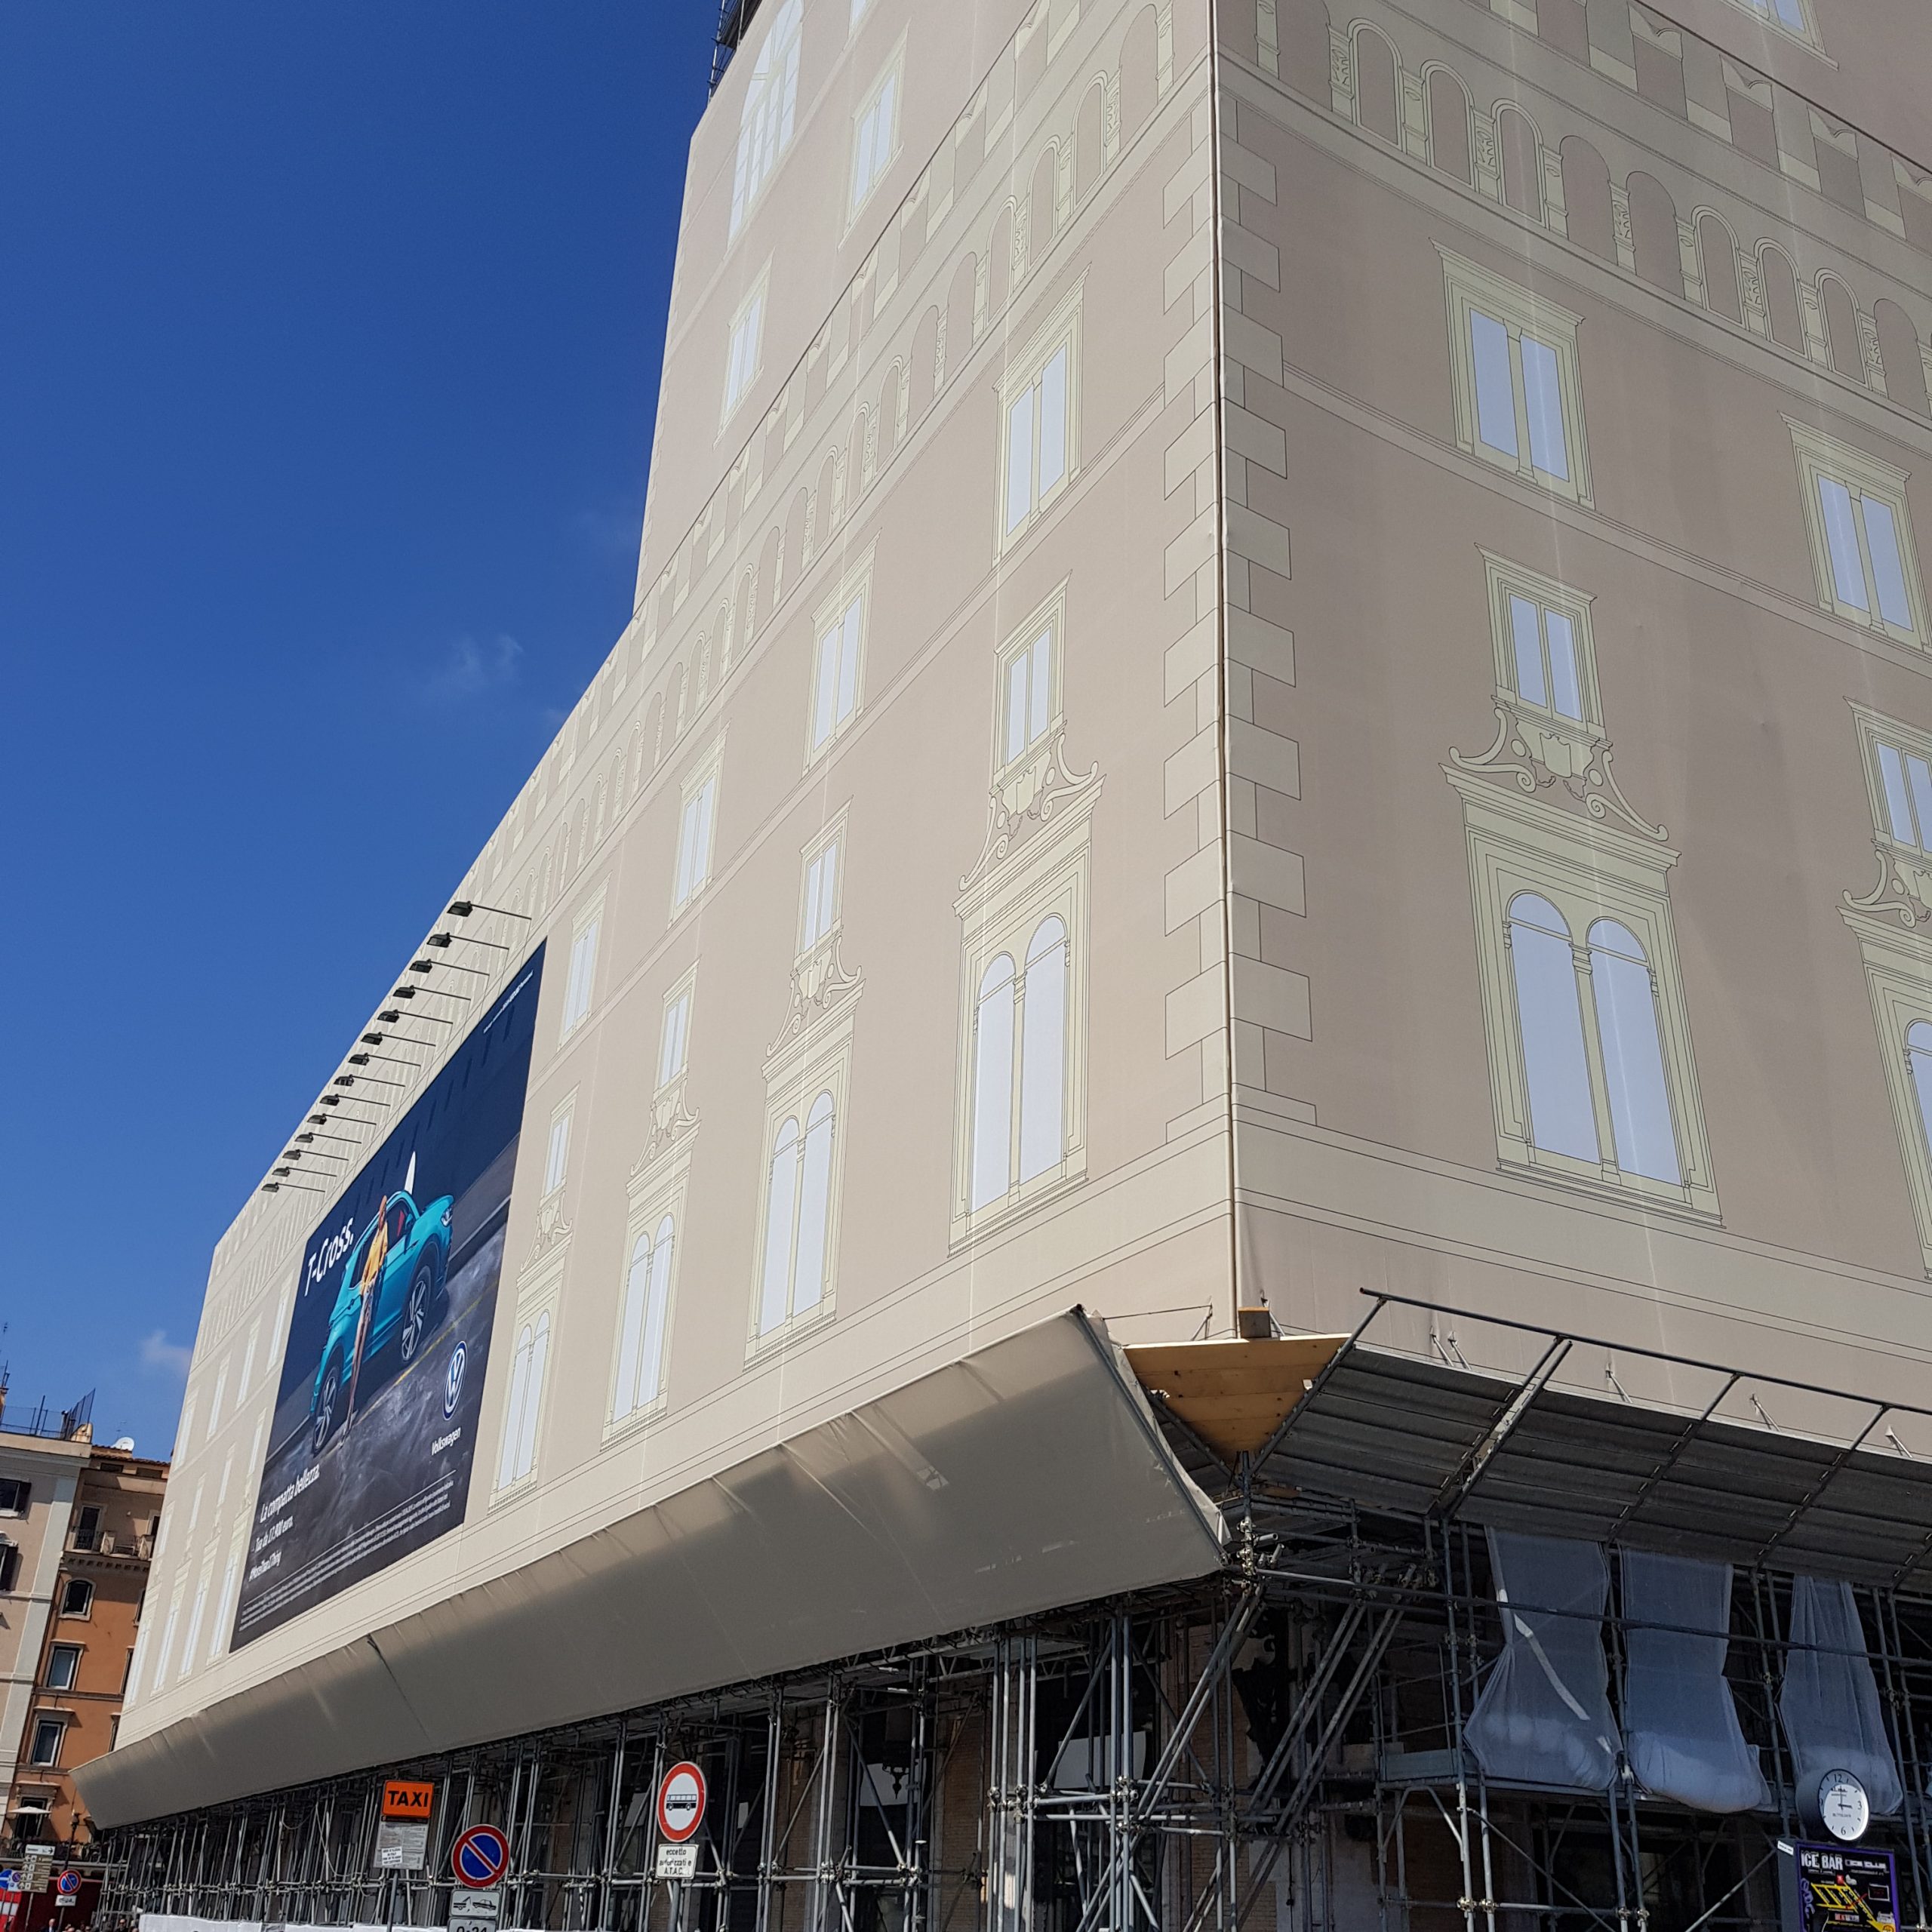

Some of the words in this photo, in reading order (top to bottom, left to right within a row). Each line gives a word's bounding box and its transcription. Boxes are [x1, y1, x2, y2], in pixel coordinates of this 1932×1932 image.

[431, 1426, 461, 1455] Volkswagen
[260, 1503, 268, 1524] La
[267, 1483, 295, 1515] compatta
[1834, 1774, 1842, 1783] 12
[388, 1790, 429, 1807] TAXI
[1857, 1801, 1863, 1810] 3
[1841, 1826, 1846, 1835] 6
[1801, 1850, 1820, 1869] ICE
[1821, 1853, 1843, 1870] BAR
